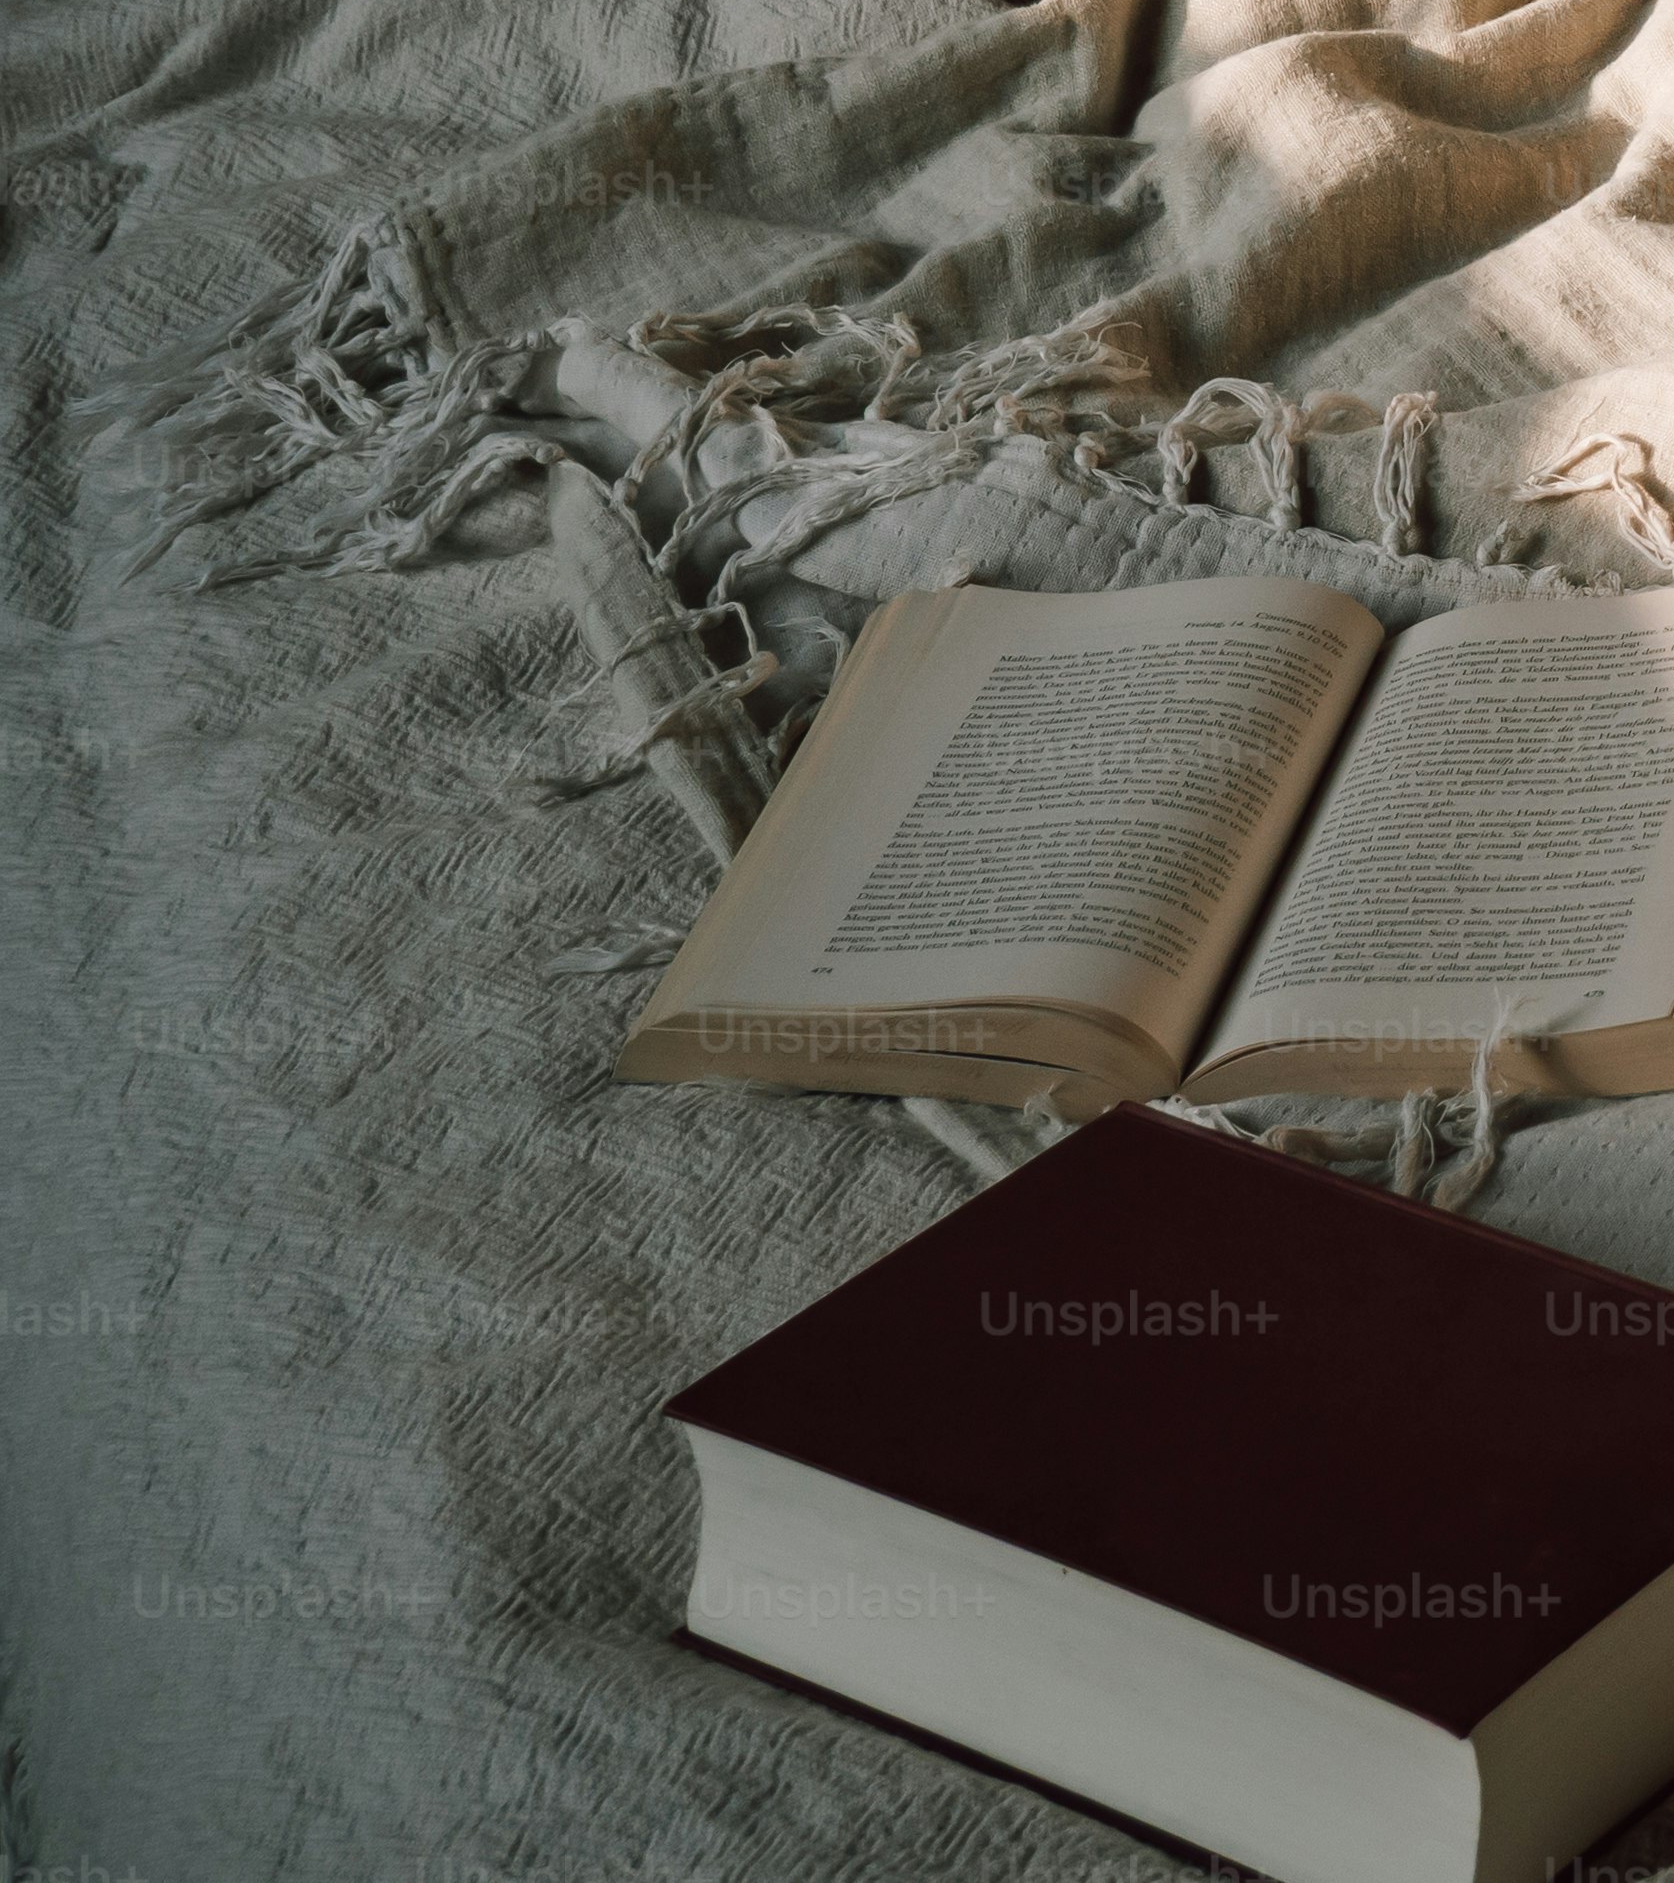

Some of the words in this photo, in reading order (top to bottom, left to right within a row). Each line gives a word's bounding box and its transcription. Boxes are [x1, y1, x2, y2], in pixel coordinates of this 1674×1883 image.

[1250, 622, 1292, 636] August,
[1323, 642, 1344, 658] Uhr
[1256, 612, 1318, 633] Cincinnati,
[1321, 629, 1348, 649] Ohio
[1458, 640, 1481, 648] dass
[1501, 636, 1528, 645] auch
[1560, 633, 1617, 644] Poolparty
[1621, 629, 1658, 640] plante.
[1000, 655, 1045, 663] Mallory
[1050, 653, 1078, 661] hatte
[1082, 650, 1113, 659] kaum
[1118, 646, 1136, 654] die
[1224, 639, 1270, 651] Zimmer
[1275, 645, 1310, 664] hinter
[1456, 647, 1518, 659] gewaschen
[1521, 646, 1544, 654] und
[1547, 641, 1644, 653] zusammengelegt.
[989, 674, 1033, 683] vergrub
[1036, 672, 1054, 680] das
[1058, 668, 1101, 679] Gesicht
[1118, 664, 1136, 672] der
[1184, 659, 1240, 667] Bestimmt
[1219, 649, 1252, 658] kroch
[1255, 654, 1281, 665] zum
[1308, 671, 1329, 689] und
[1499, 676, 1519, 684] die
[1564, 673, 1611, 682] Samstag
[1617, 670, 1636, 679] vor
[846, 945, 881, 953] Filme
[884, 944, 919, 952] schon
[920, 942, 948, 952] jetzt
[1019, 935, 1044, 943] dem
[1048, 934, 1131, 953] offensichtlich
[1134, 949, 1164, 967] nicht
[1331, 964, 1375, 972] gezeigt
[1397, 963, 1415, 971] die
[1437, 962, 1470, 972] selbst
[1475, 962, 1525, 972] angelegt
[1568, 959, 1582, 967] Er
[1587, 956, 1617, 965] hatte
[1344, 973, 1362, 983] ihr
[1364, 974, 1411, 983] gezeigt,
[1414, 974, 1435, 982] auf
[1436, 974, 1473, 983] denen
[1496, 973, 1515, 982] wie
[1519, 972, 1538, 981] ein
[1583, 989, 1605, 998] 475
